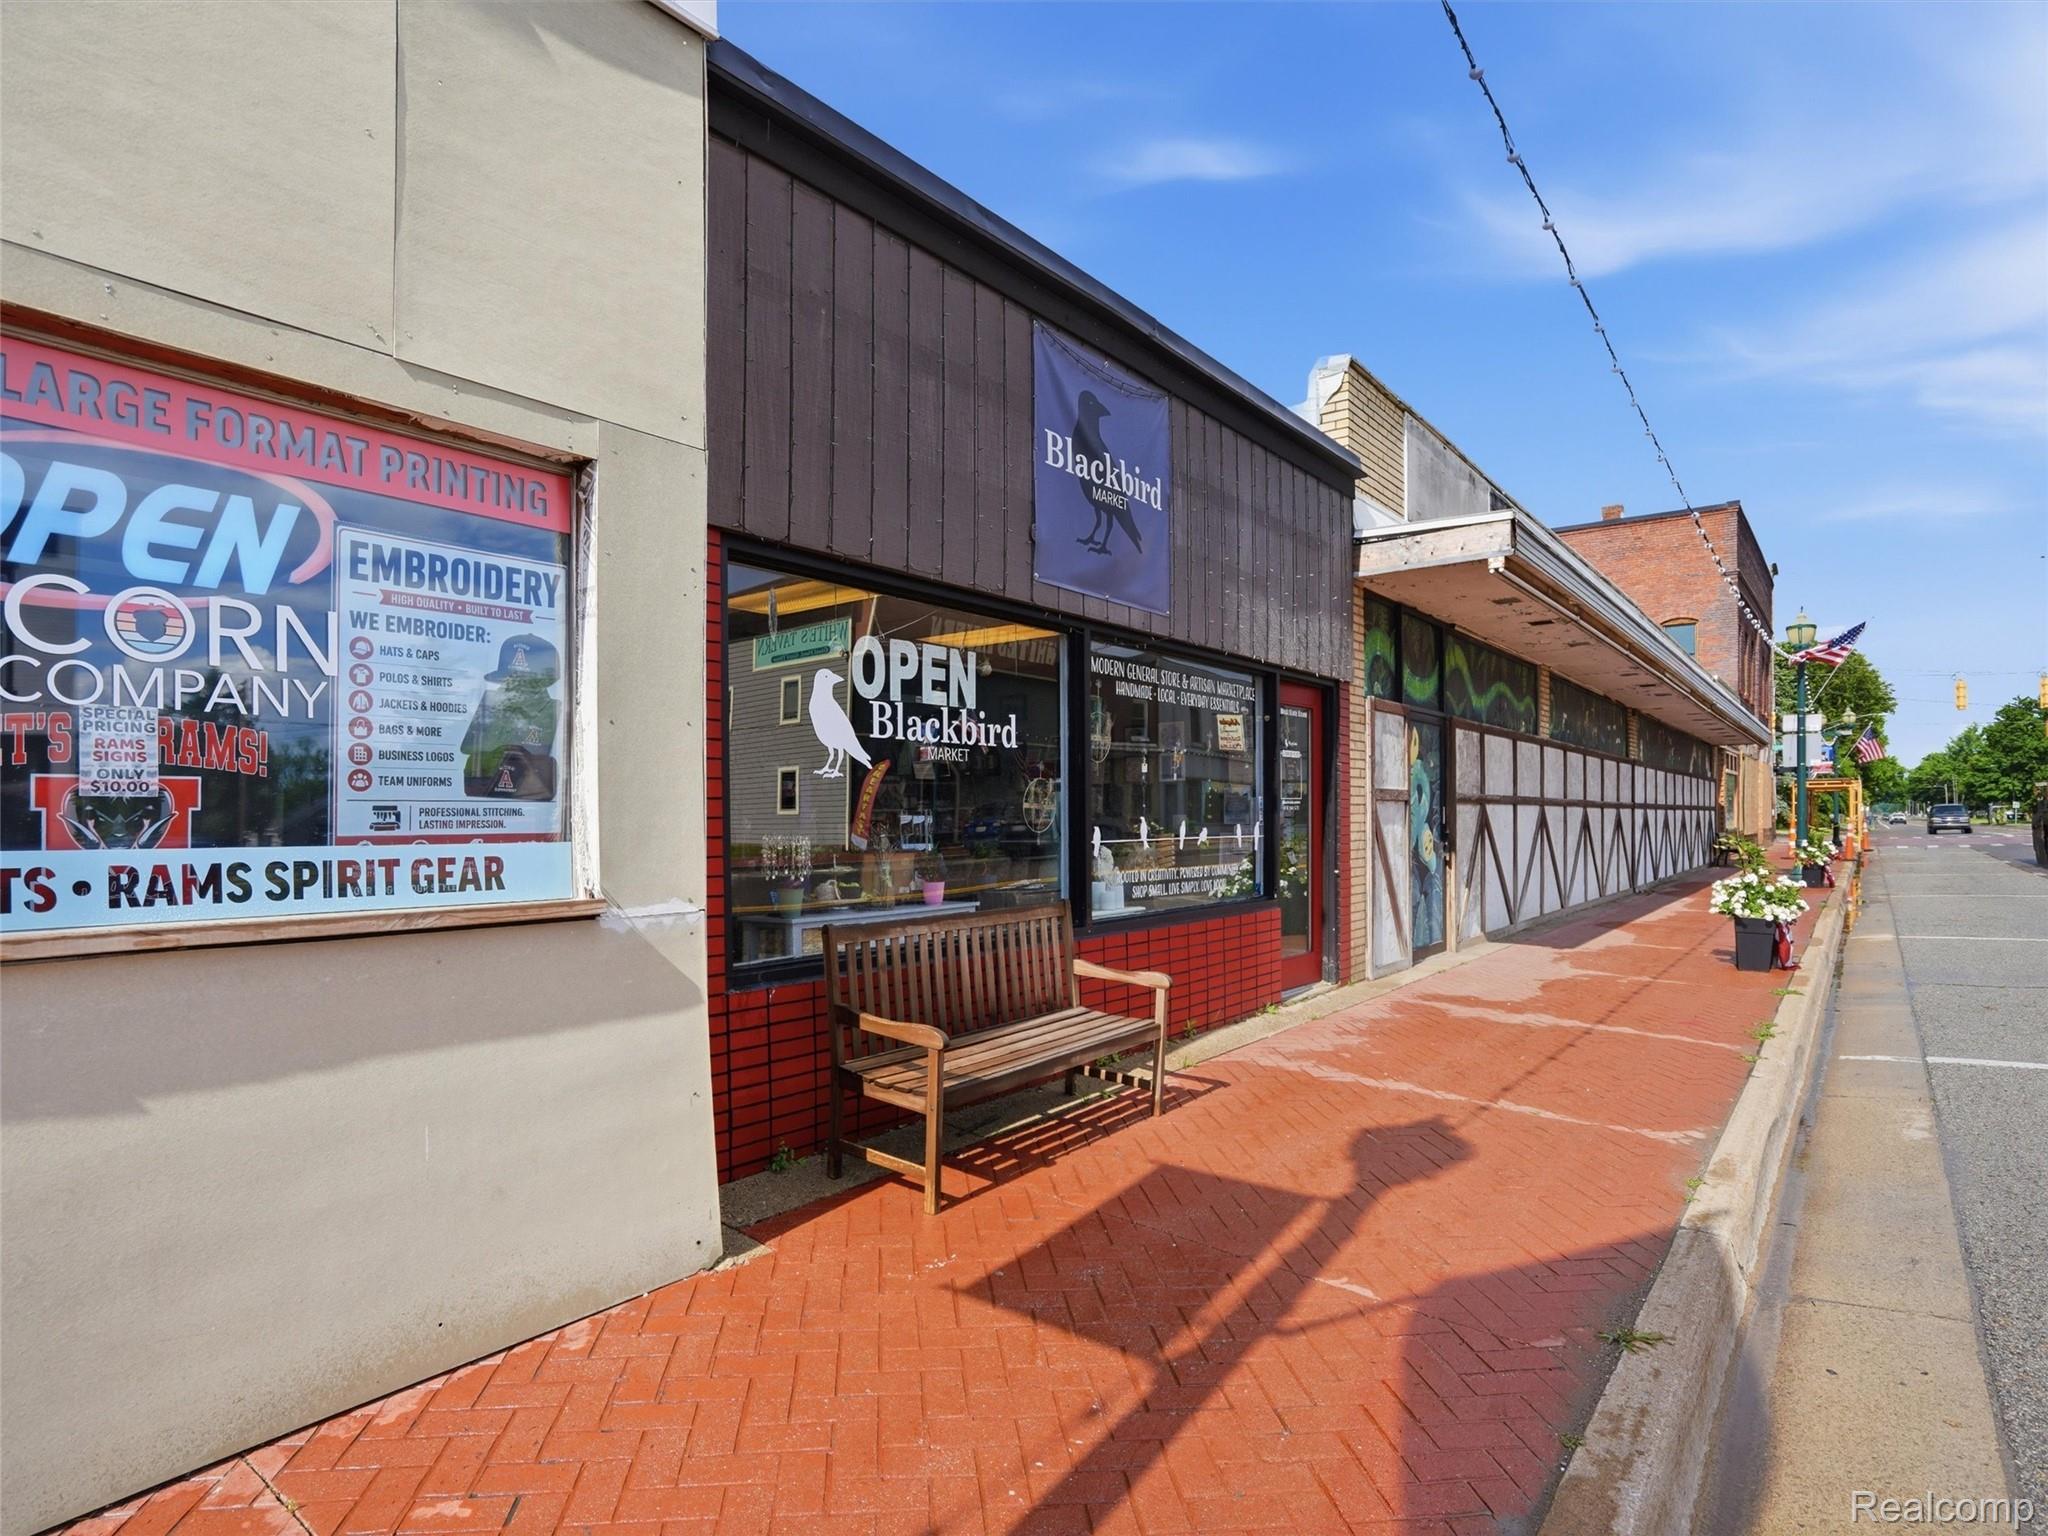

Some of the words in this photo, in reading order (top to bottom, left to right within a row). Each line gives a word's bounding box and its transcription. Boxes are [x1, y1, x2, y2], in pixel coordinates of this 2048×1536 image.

[0, 353, 171, 436] LARGE
[185, 397, 368, 477] FORMAT
[379, 444, 548, 517] PRINTING
[1044, 428, 1162, 512] Blackbird
[1092, 486, 1129, 511] MARKET
[0, 453, 301, 595] PEN
[350, 540, 560, 608] EMBROIDERY
[391, 593, 414, 607] HIGH
[416, 596, 454, 611] QUALITY
[465, 603, 488, 616] BUILT
[490, 606, 502, 618] TO
[503, 608, 524, 620] LAST
[4, 573, 338, 677] CORN
[349, 610, 379, 630] WE
[386, 614, 491, 643] EMBROIDER:
[379, 645, 404, 658] HATS
[406, 648, 413, 658] &
[415, 649, 440, 661] CAPS
[379, 672, 409, 684] POLOS
[411, 674, 419, 685] &
[421, 675, 453, 688] SHIRTS
[852, 635, 977, 709] OPEN
[1091, 656, 1124, 678] MODERN
[1127, 664, 1159, 685] GENERAL
[1160, 670, 1180, 689] STORE
[1182, 674, 1189, 689] &
[1190, 676, 1216, 694] ARTISAN
[1217, 680, 1255, 701] MARKETPLACE
[0, 655, 328, 719] COMPANY
[379, 698, 419, 711] JACKETS
[421, 700, 427, 712] &
[430, 701, 468, 713] HOODIES
[1116, 681, 1152, 701] HANDMADE
[1158, 689, 1176, 704] LOCAL
[1181, 692, 1209, 709] EVERYDAY
[1210, 697, 1239, 714] ESSENTIALS
[82, 707, 156, 721] SPECIAL
[82, 719, 157, 734] PRICING
[378, 724, 404, 736] BAGS
[407, 725, 413, 736] &
[416, 725, 442, 737] MORE
[869, 701, 1018, 748] Blackbird
[0, 712, 72, 766] T'S
[158, 716, 269, 777] RAMS!
[94, 737, 145, 750] RAMS
[92, 751, 147, 763] SIGNS
[378, 749, 424, 762] BUSINESS
[425, 751, 455, 762] LOGOS
[928, 746, 970, 762] MARKET
[96, 768, 145, 780] ONLY
[378, 775, 404, 787] TEAM
[406, 776, 452, 787] UNIFORMS
[90, 781, 150, 793] $10.00
[419, 807, 481, 817] PROFESSIONAL
[482, 806, 525, 817] STITCHING.
[419, 819, 454, 830] LASTING
[455, 819, 506, 830] IMPRESSION.
[1180, 866, 1202, 878] POWERED
[108, 862, 252, 909] RAMS
[265, 858, 400, 902] SPIRIT
[411, 856, 506, 895] GEAR
[1132, 885, 1147, 899] SHOP
